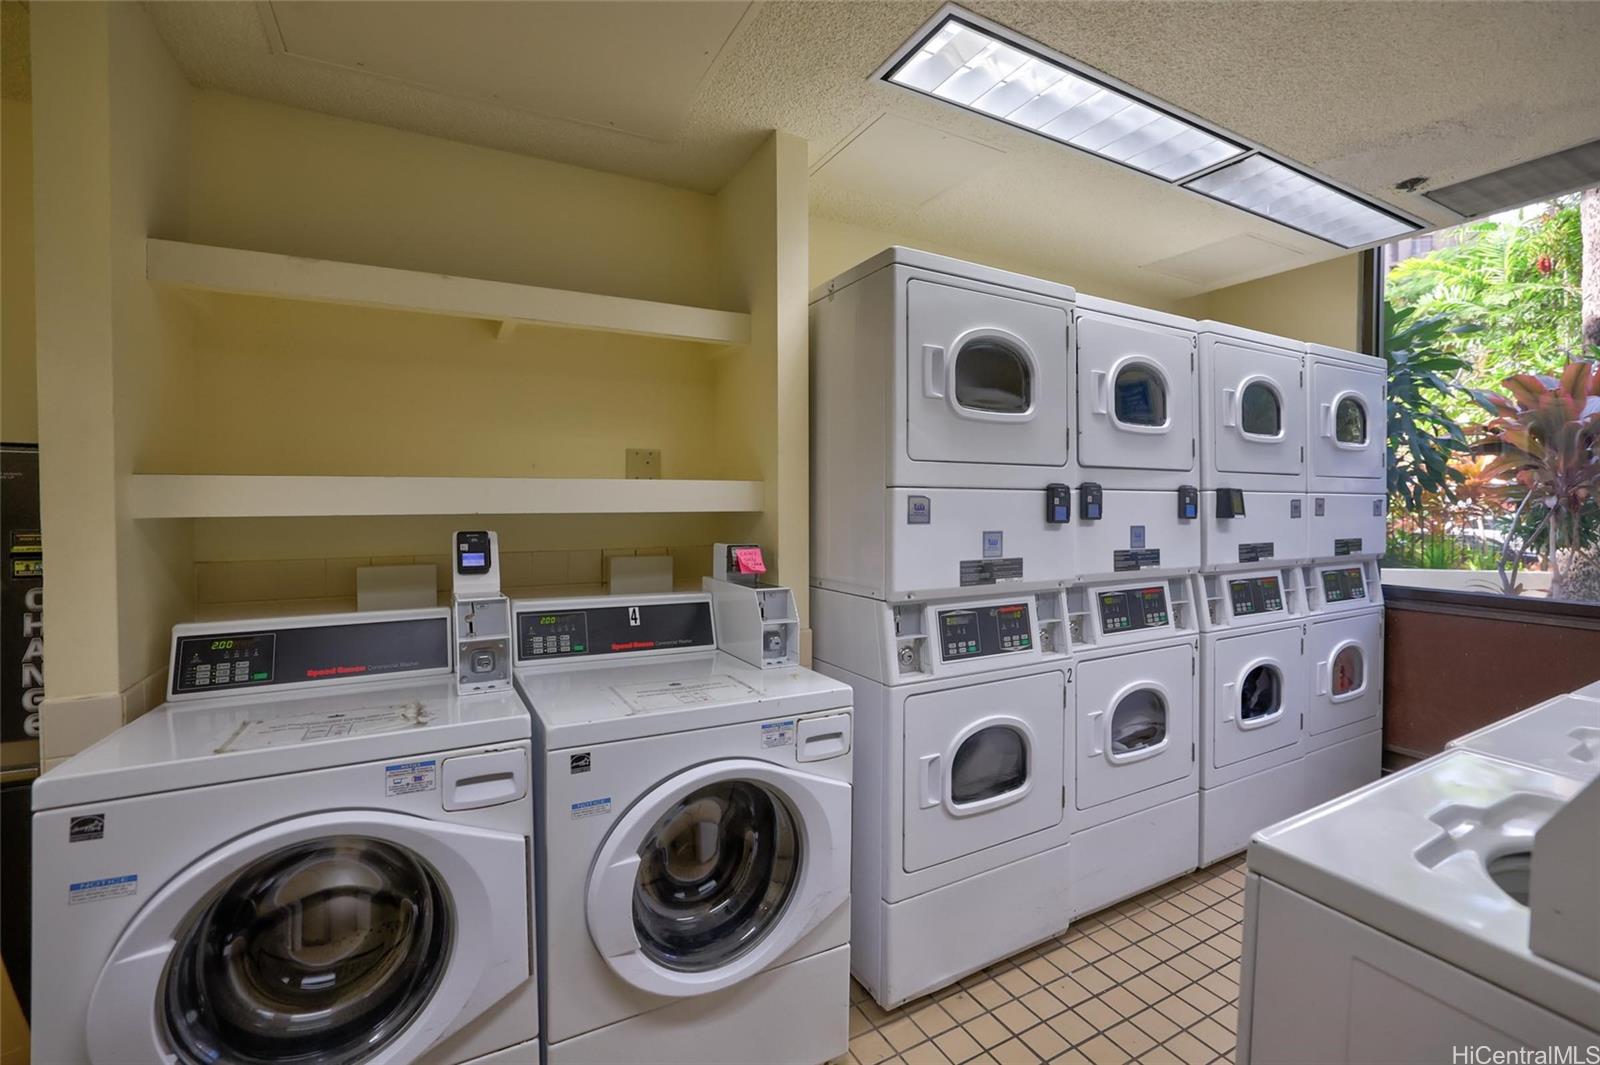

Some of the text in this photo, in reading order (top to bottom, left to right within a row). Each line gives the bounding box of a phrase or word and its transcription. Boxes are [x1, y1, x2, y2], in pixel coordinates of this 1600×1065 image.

[1192, 335, 1197, 349] 3
[631, 607, 637, 624] 4
[1066, 667, 1073, 684] 2
